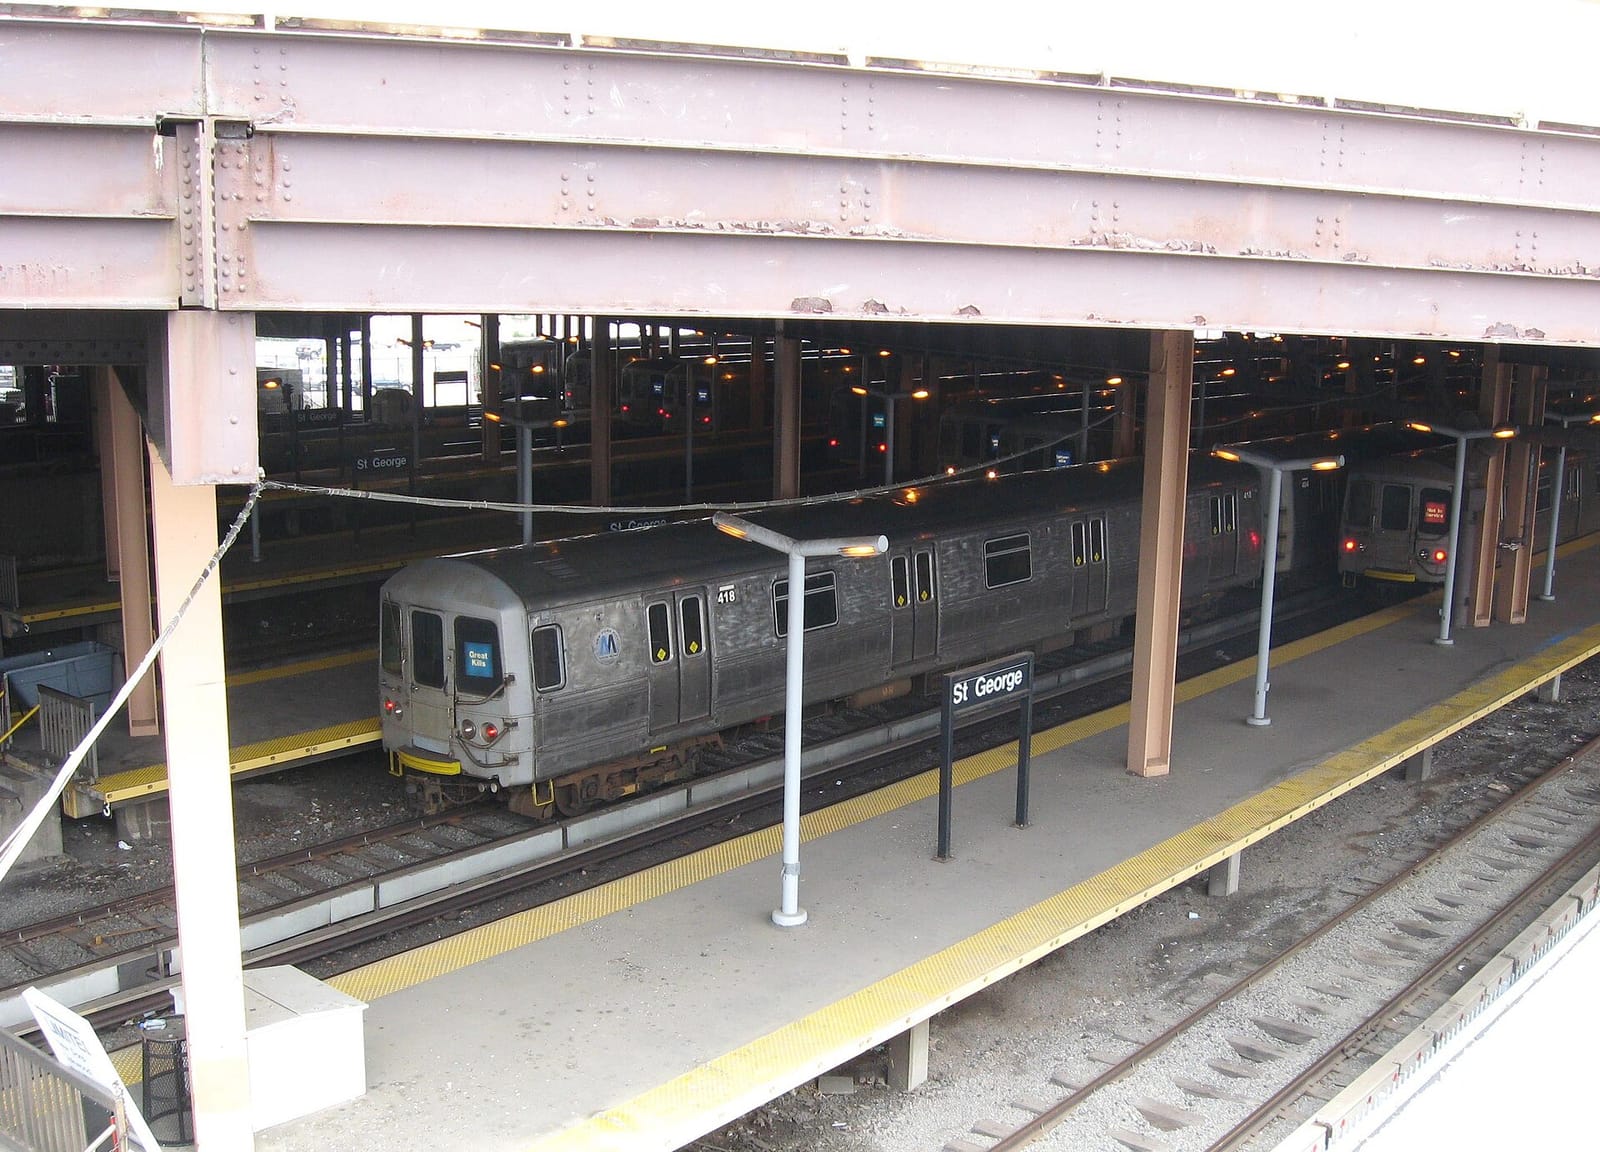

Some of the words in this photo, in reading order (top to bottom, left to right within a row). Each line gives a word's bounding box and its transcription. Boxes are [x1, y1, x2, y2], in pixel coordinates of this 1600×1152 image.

[357, 458, 368, 470] St
[372, 456, 407, 468] George
[717, 590, 736, 604] 418
[468, 650, 489, 660] Great
[471, 658, 486, 667] Kills
[953, 681, 969, 705] St
[975, 669, 1023, 697] George
[103, 801, 111, 817] 3
